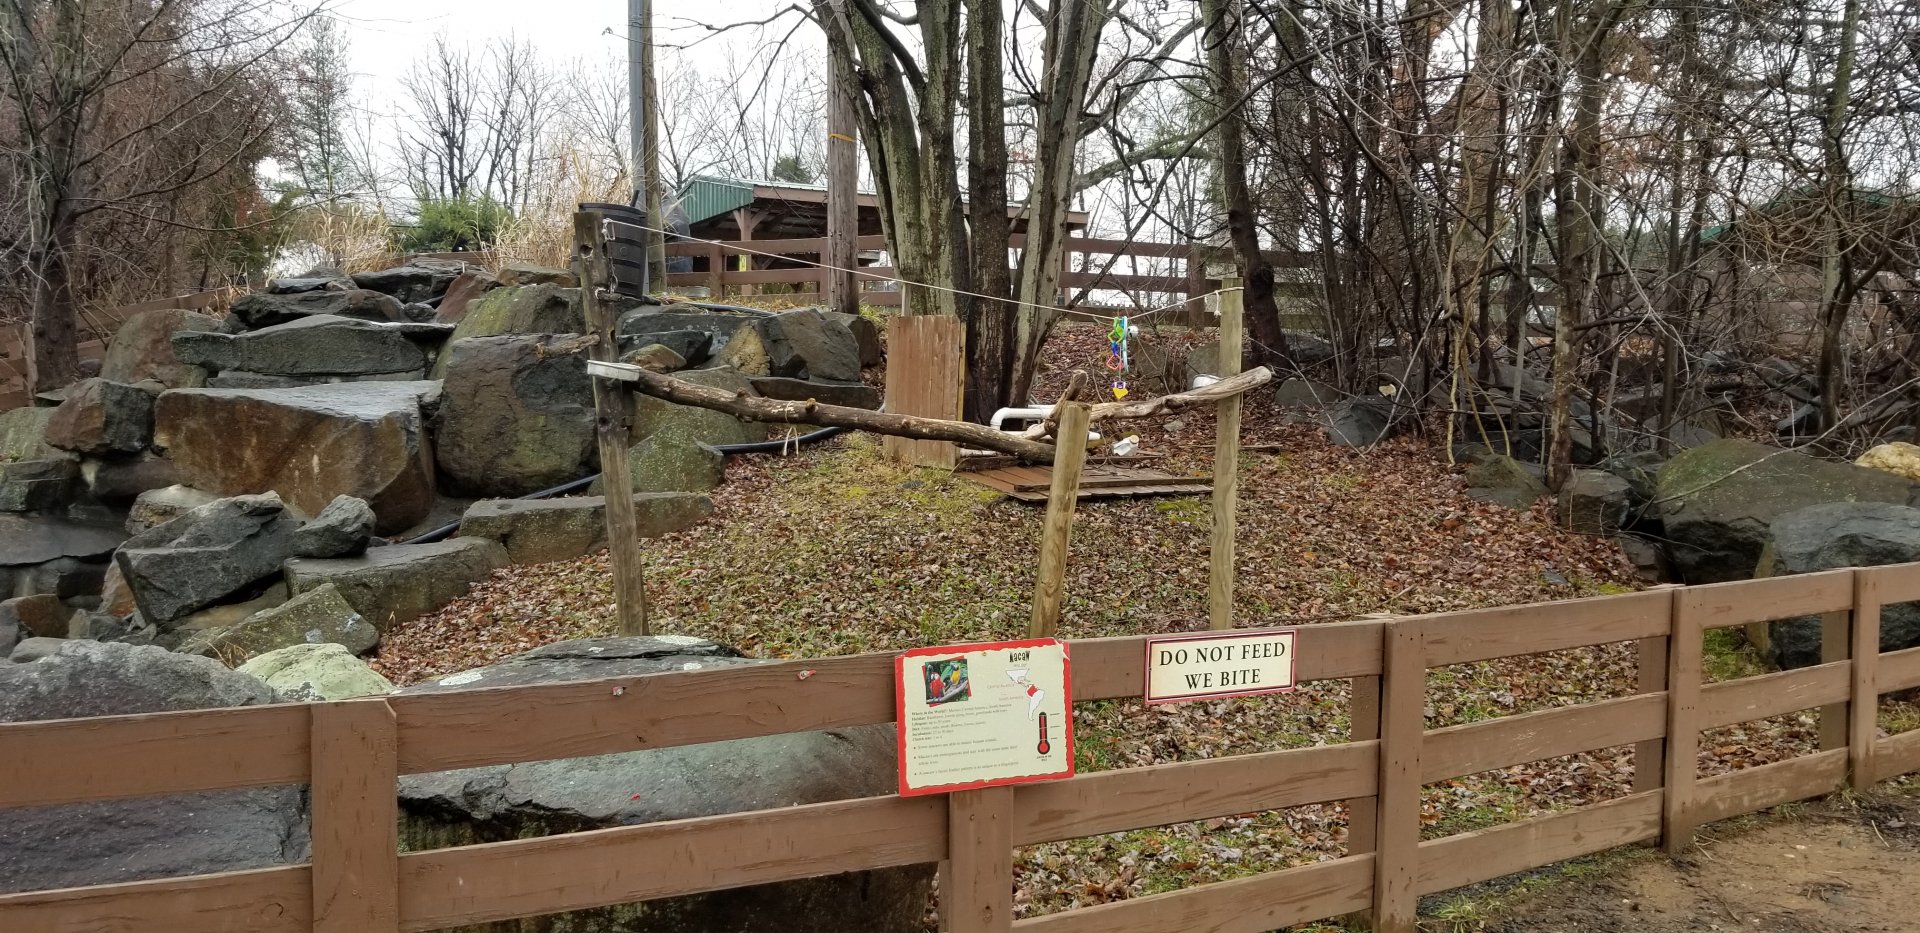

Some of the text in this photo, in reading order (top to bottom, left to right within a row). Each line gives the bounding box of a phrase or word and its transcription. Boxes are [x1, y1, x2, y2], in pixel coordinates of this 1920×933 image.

[1159, 641, 1286, 666] DO NOT FEED
[1184, 668, 1261, 690] WE BITE
